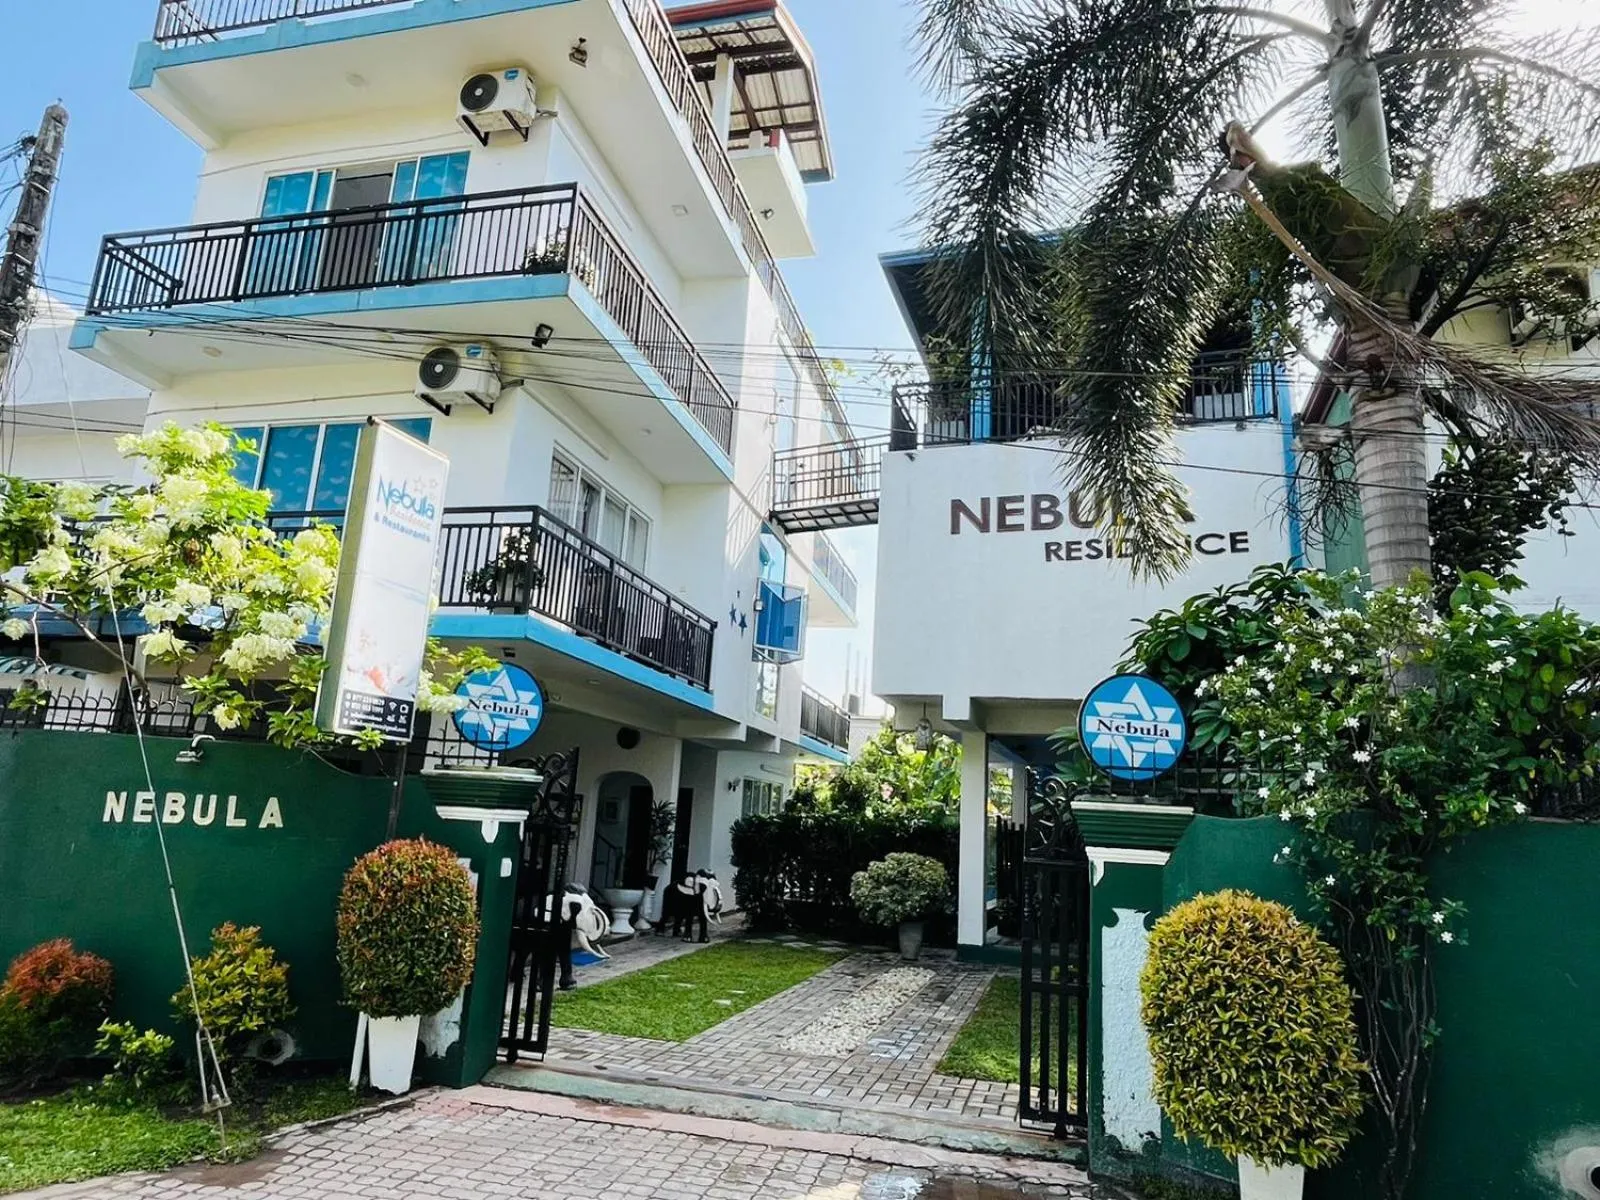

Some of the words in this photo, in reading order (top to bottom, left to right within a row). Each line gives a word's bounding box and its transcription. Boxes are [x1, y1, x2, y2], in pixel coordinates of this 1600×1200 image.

[376, 475, 435, 520] Nebula
[468, 698, 529, 717] Nebula
[1096, 718, 1170, 738] Nebula
[102, 791, 284, 829] NEBULA
